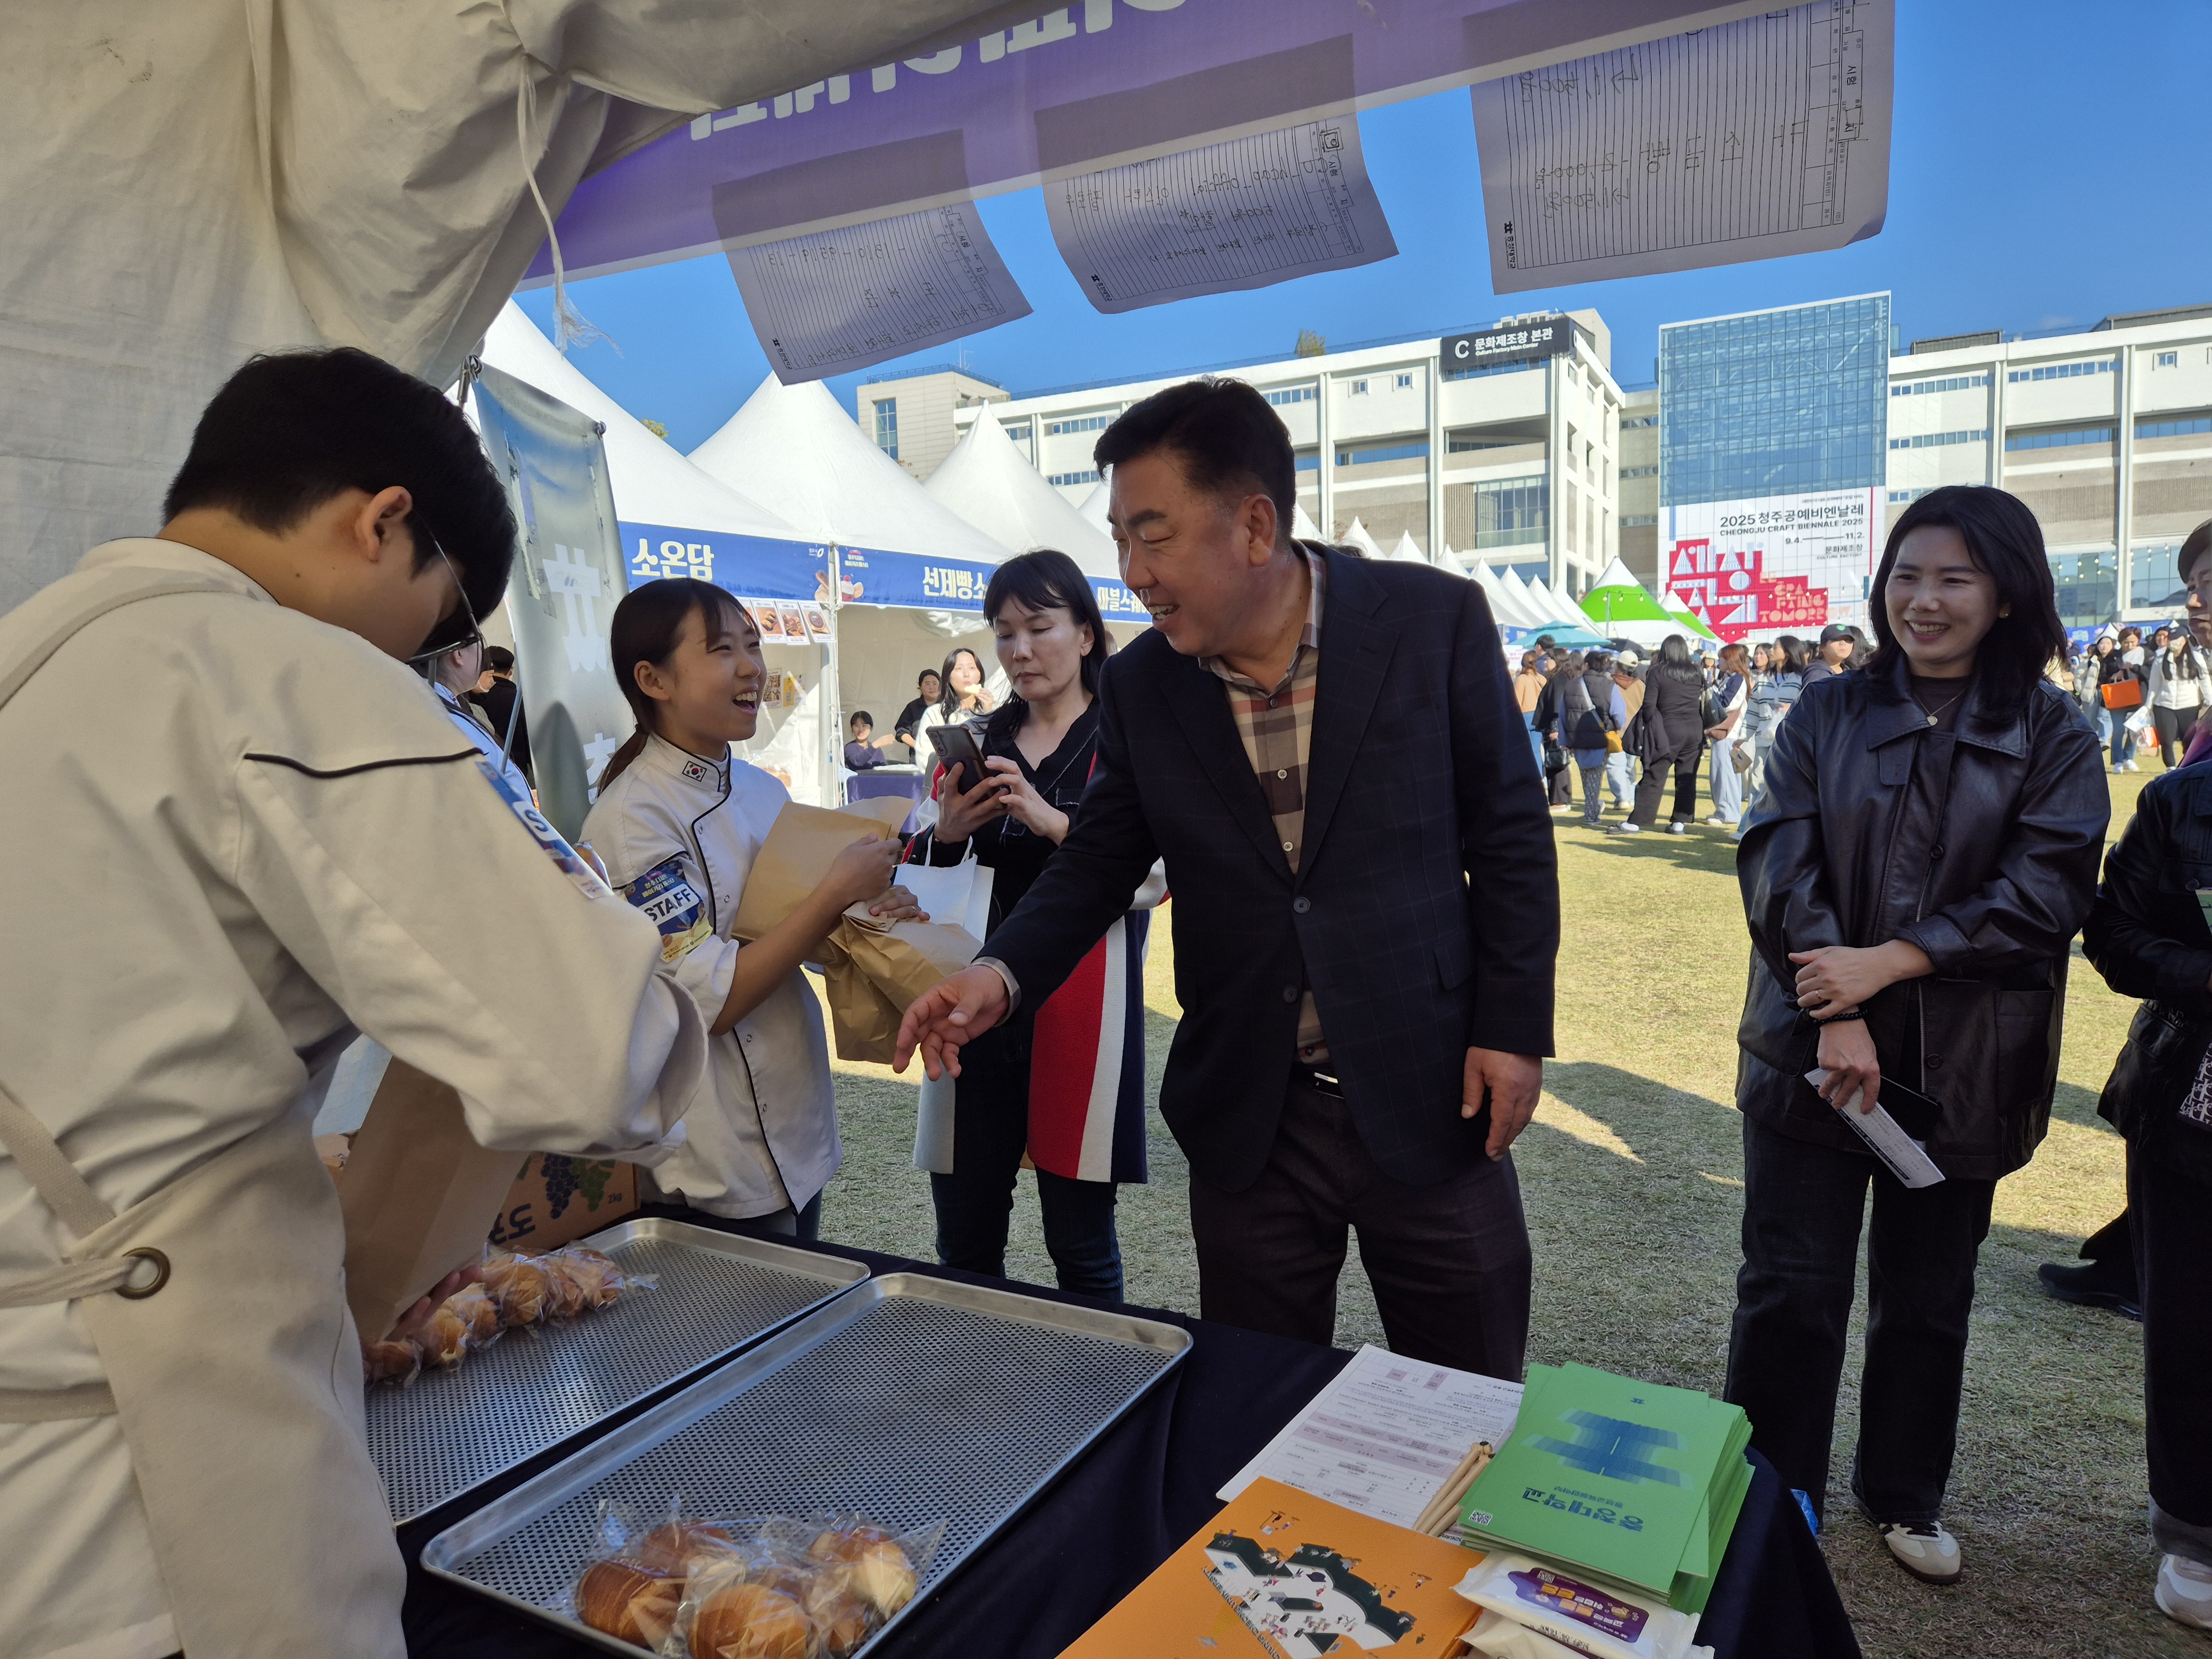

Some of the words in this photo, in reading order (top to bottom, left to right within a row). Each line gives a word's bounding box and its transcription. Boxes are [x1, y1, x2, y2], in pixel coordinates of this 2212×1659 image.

[1846, 65, 1857, 86] 시험
[1474, 331, 1528, 350] 문화제조창
[1531, 327, 1553, 342] 본관
[1720, 514, 1755, 526] 2025
[1759, 503, 1864, 525] 청주공예비엔날레
[1720, 528, 1765, 536] CHEONGJU
[1798, 521, 1839, 529] BIENNALE
[632, 538, 714, 581] 소온담
[1825, 544, 1863, 553] 문화제조창
[1759, 606, 1851, 623] TOMORROW
[644, 888, 691, 922] STAFF
[608, 1192, 623, 1204] 2kg
[1522, 1487, 1644, 1532] 충청대학교
